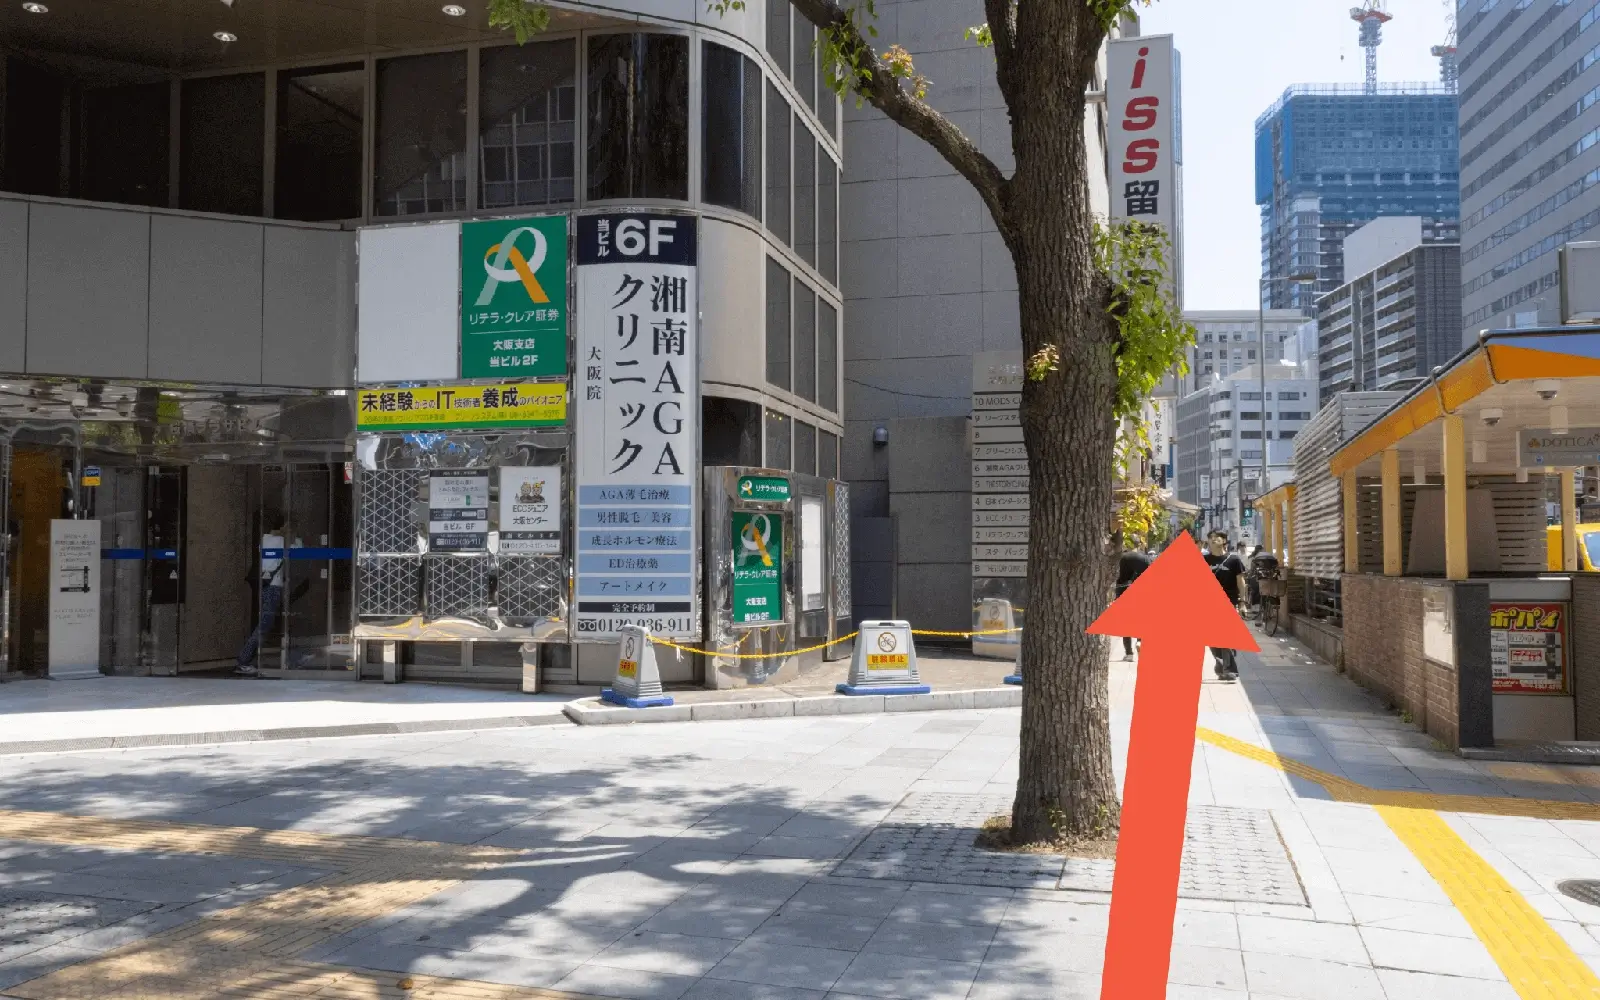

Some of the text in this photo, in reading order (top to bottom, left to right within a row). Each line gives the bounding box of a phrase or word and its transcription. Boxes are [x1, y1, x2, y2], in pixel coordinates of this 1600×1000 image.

[597, 218, 610, 257] 当ビル
[615, 218, 677, 256] 6F
[469, 308, 560, 325] リテラ・クレア証券
[493, 338, 535, 351] 大阪支店
[586, 346, 602, 401] 大阪院
[609, 273, 646, 475] クリニック
[650, 274, 688, 475] 湘南AGA
[974, 431, 980, 439] 8
[975, 447, 980, 456] 7
[974, 464, 980, 472] 6
[974, 497, 980, 505] 4
[975, 514, 980, 522] 3
[591, 535, 677, 546] 成長ホルモン療法
[975, 531, 980, 539] 2
[600, 581, 667, 592] アートメイク
[598, 618, 691, 633] 012036-911
